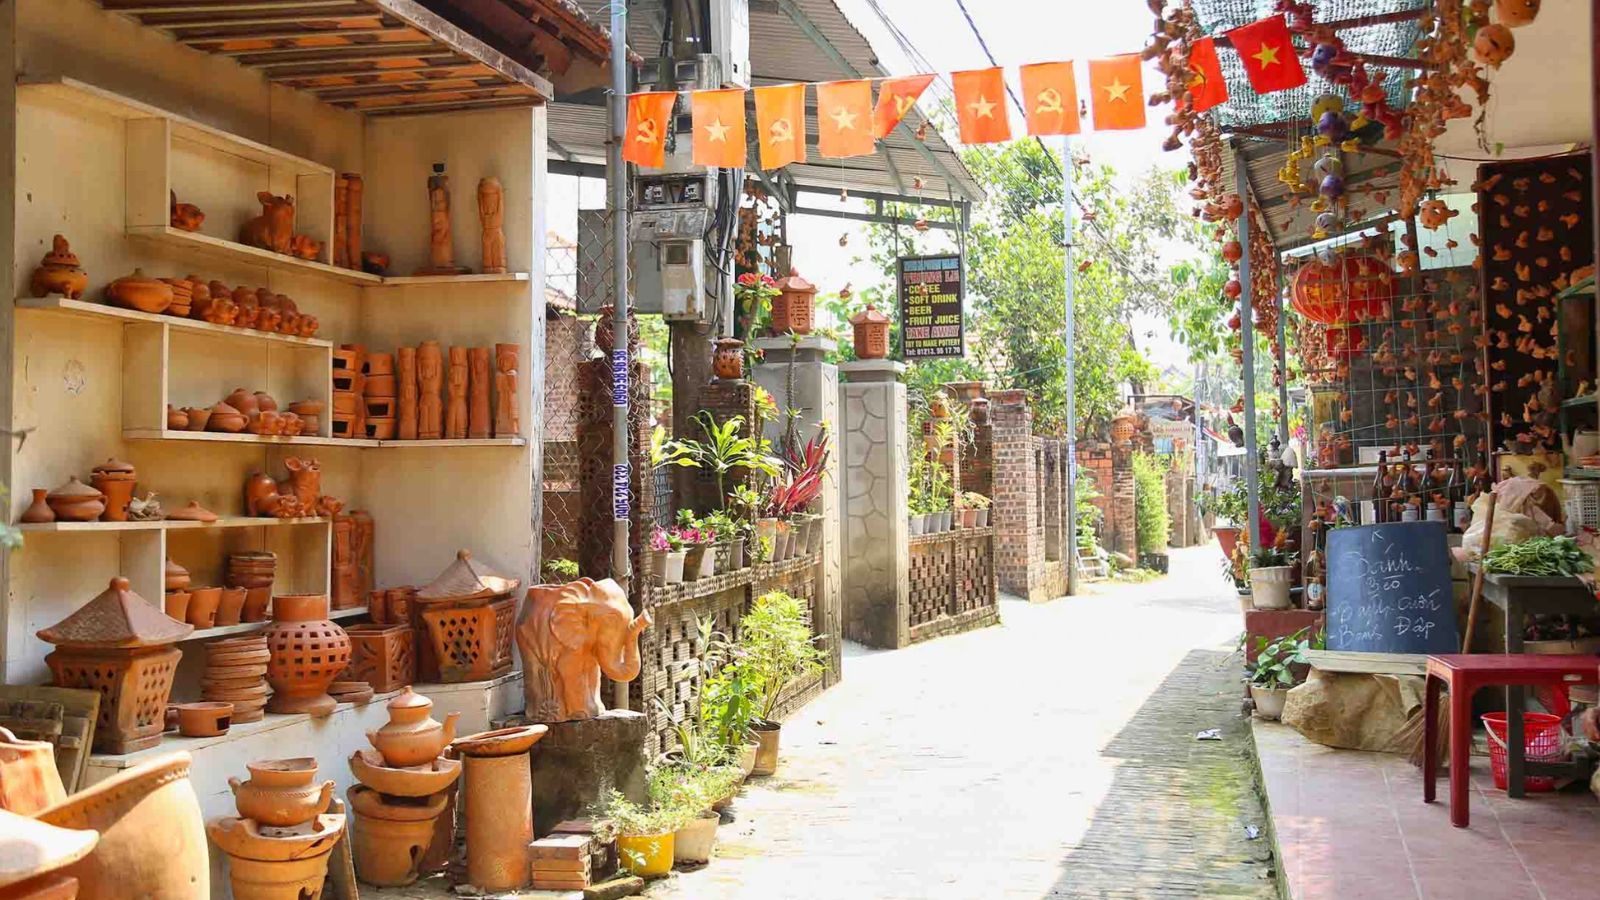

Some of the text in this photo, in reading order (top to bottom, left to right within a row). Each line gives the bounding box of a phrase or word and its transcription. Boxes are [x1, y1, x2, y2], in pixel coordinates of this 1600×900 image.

[909, 284, 940, 294] COFEE
[909, 293, 957, 304] SOFT DRINK
[909, 305, 932, 315] BEER
[909, 315, 960, 325] FRUIT JUICE
[905, 325, 960, 339] TAKE AWAY
[922, 339, 937, 347] MAKE
[938, 338, 960, 347] POTTERY
